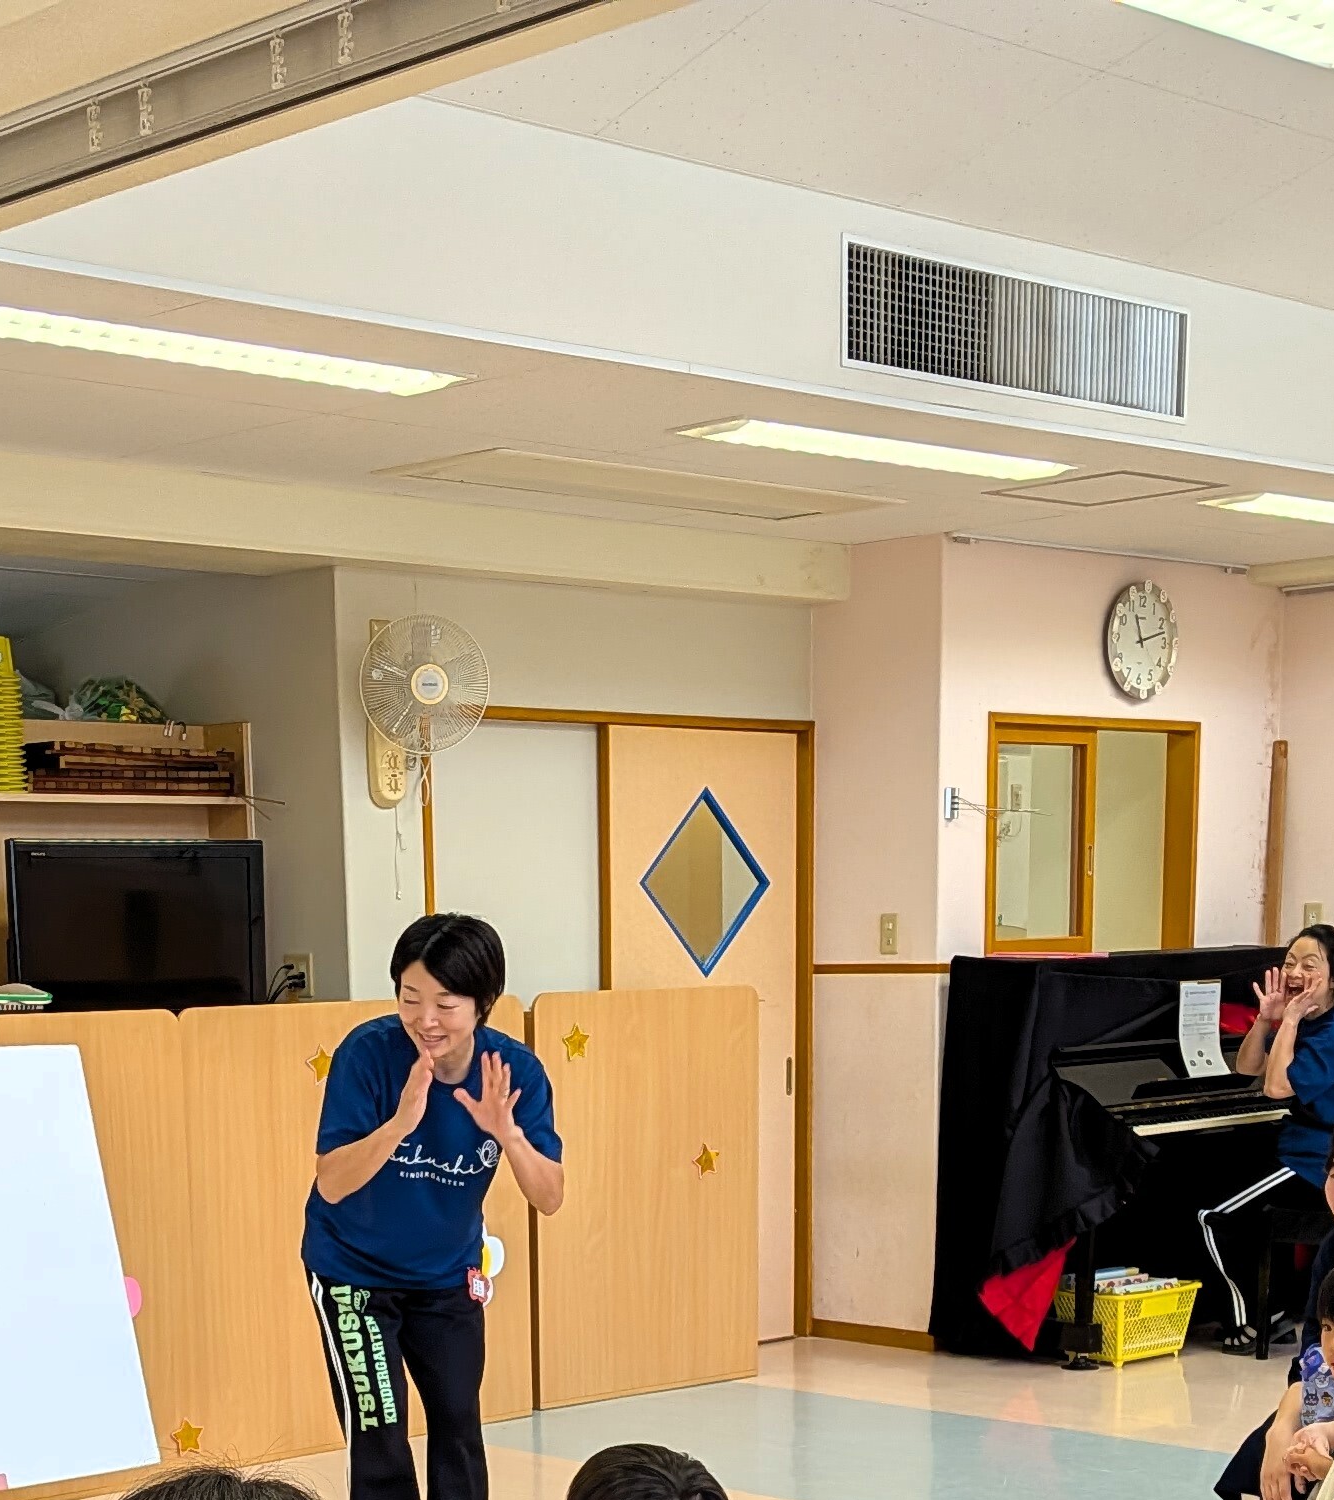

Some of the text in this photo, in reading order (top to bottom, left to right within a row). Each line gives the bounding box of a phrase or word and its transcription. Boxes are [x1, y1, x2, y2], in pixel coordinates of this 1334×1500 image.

[1139, 595, 1147, 608] 12
[1152, 602, 1156, 615] 1
[1158, 617, 1165, 630] 2
[1161, 637, 1167, 650] 3
[1156, 656, 1162, 668] 4
[1136, 673, 1142, 685] 6
[1147, 669, 1153, 681] 5
[400, 1171, 465, 1187] KINDERGARTEN
[364, 1315, 398, 1425] KINDERGARTEN
